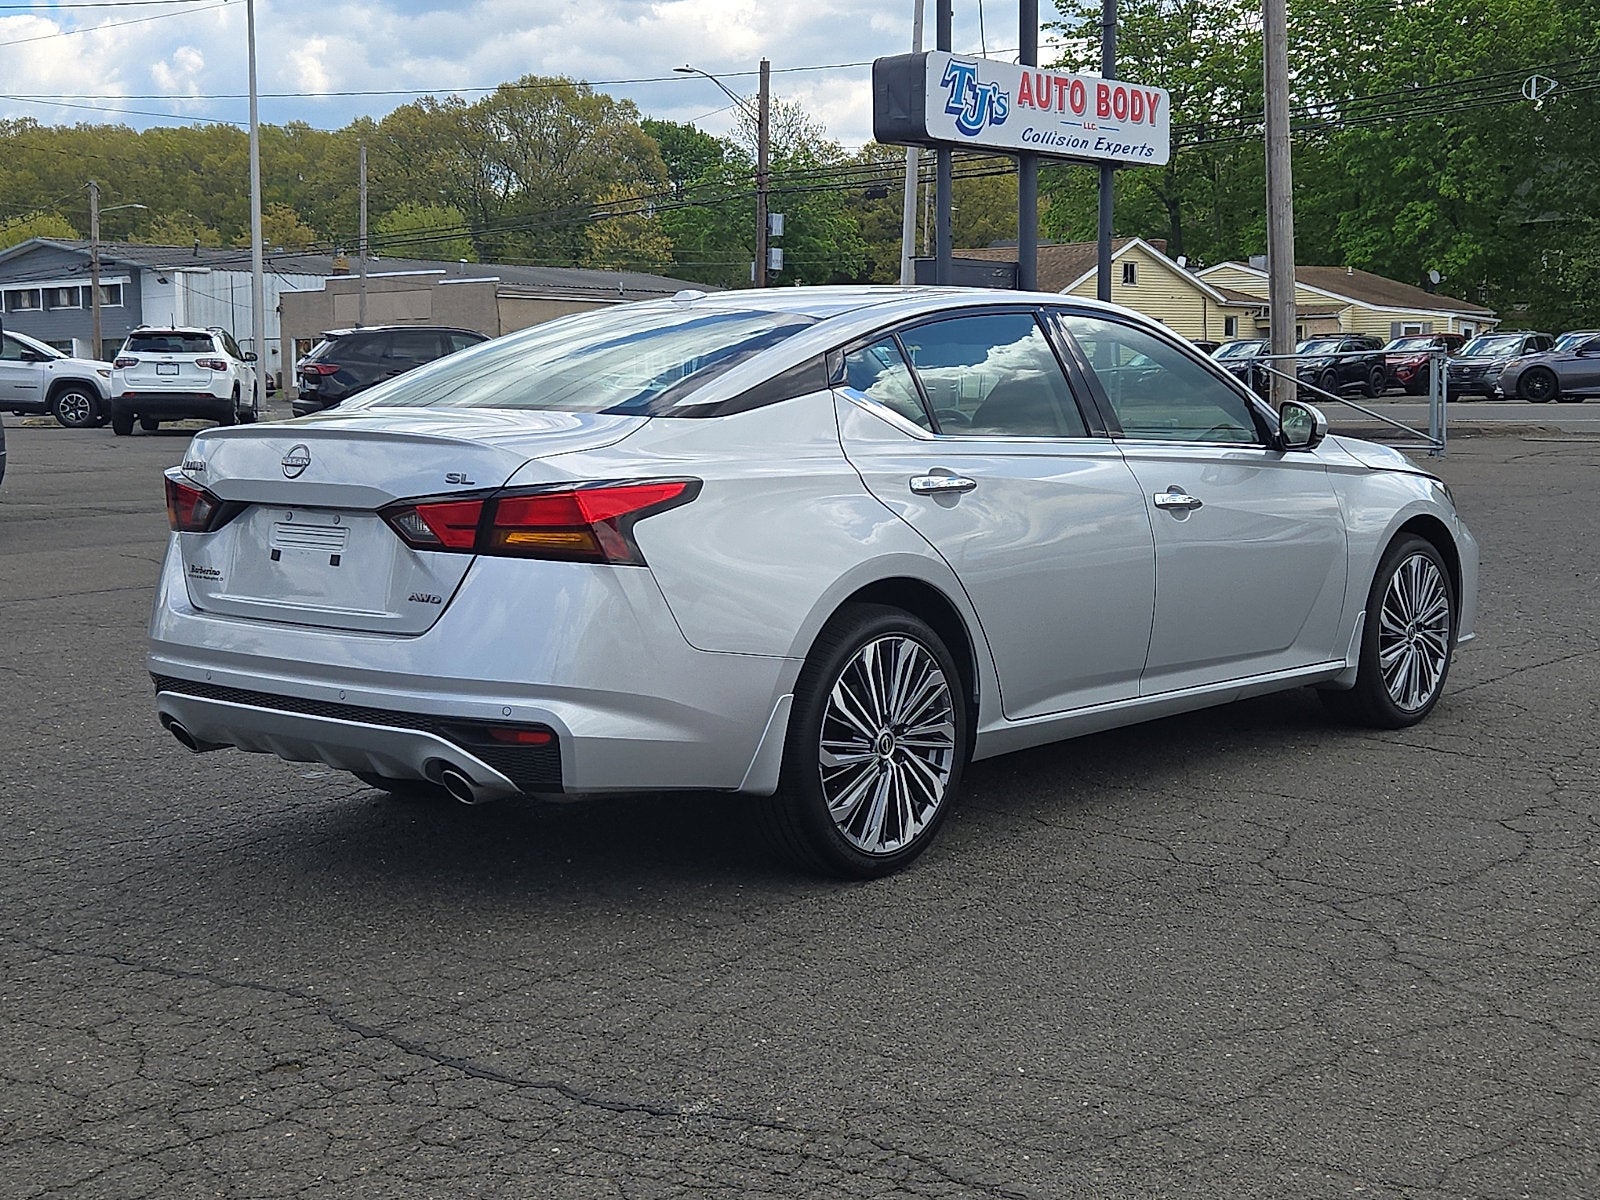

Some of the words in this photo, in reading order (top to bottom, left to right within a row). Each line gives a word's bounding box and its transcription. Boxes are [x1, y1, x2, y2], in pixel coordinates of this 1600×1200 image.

[1017, 71, 1087, 115] AUTO
[1096, 83, 1161, 127] BODY
[1021, 127, 1089, 150] Collision
[1093, 137, 1155, 156] Experts
[445, 472, 475, 485] SL
[408, 593, 442, 604] AWD
